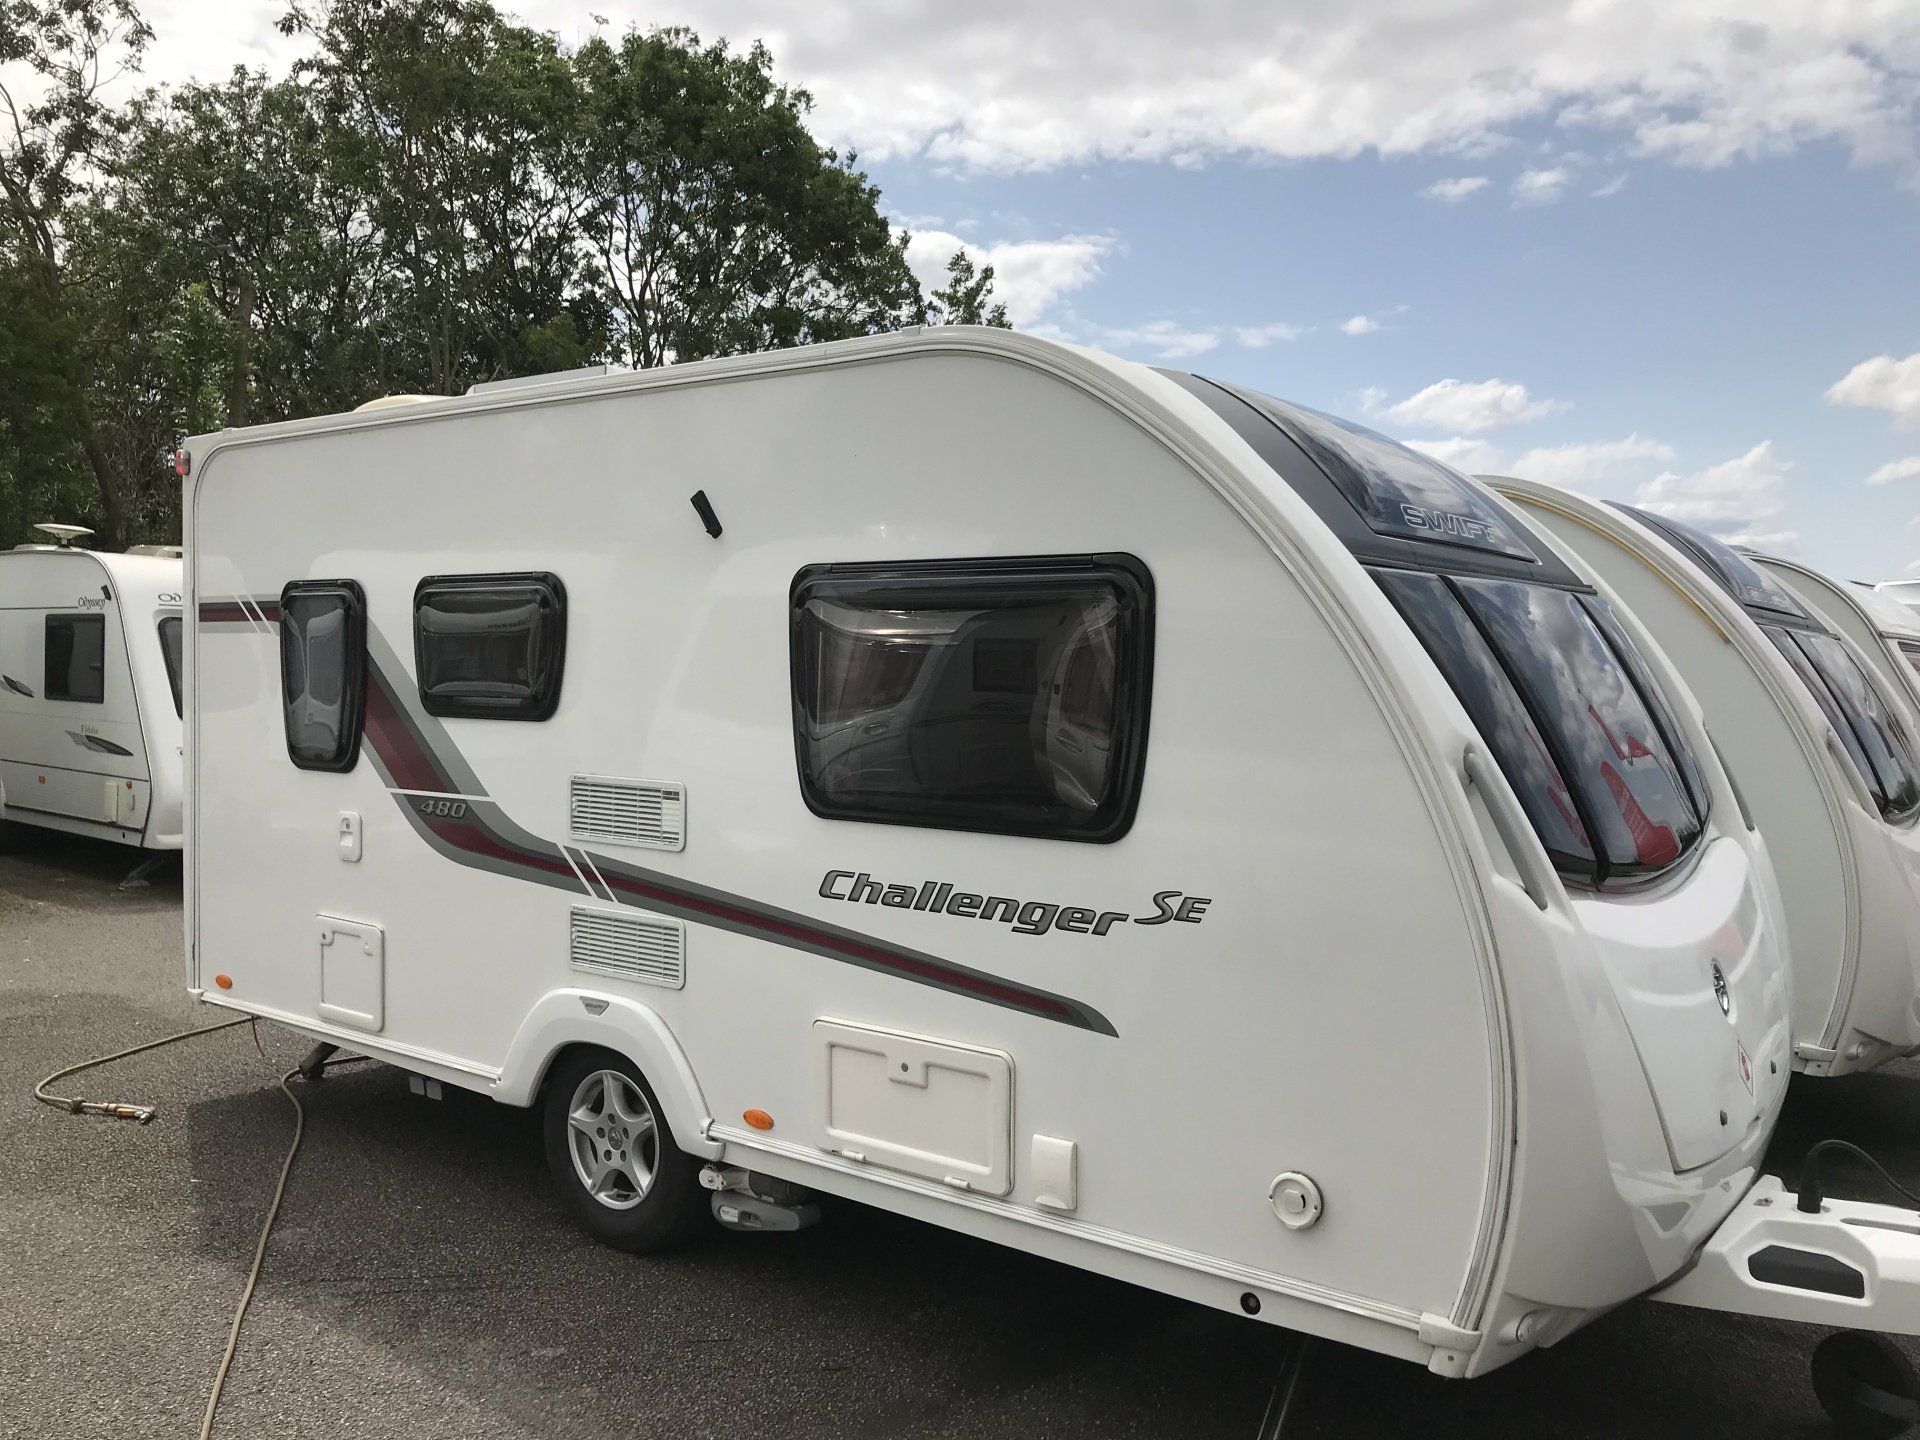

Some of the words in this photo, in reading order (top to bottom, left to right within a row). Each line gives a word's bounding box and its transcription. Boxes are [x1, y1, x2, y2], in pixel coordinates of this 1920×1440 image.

[1400, 503, 1495, 543] SWIFT
[78, 596, 106, 610] Odyssey
[419, 800, 467, 818] 480
[818, 869, 1130, 936] Challenger
[1133, 890, 1212, 926] SE
